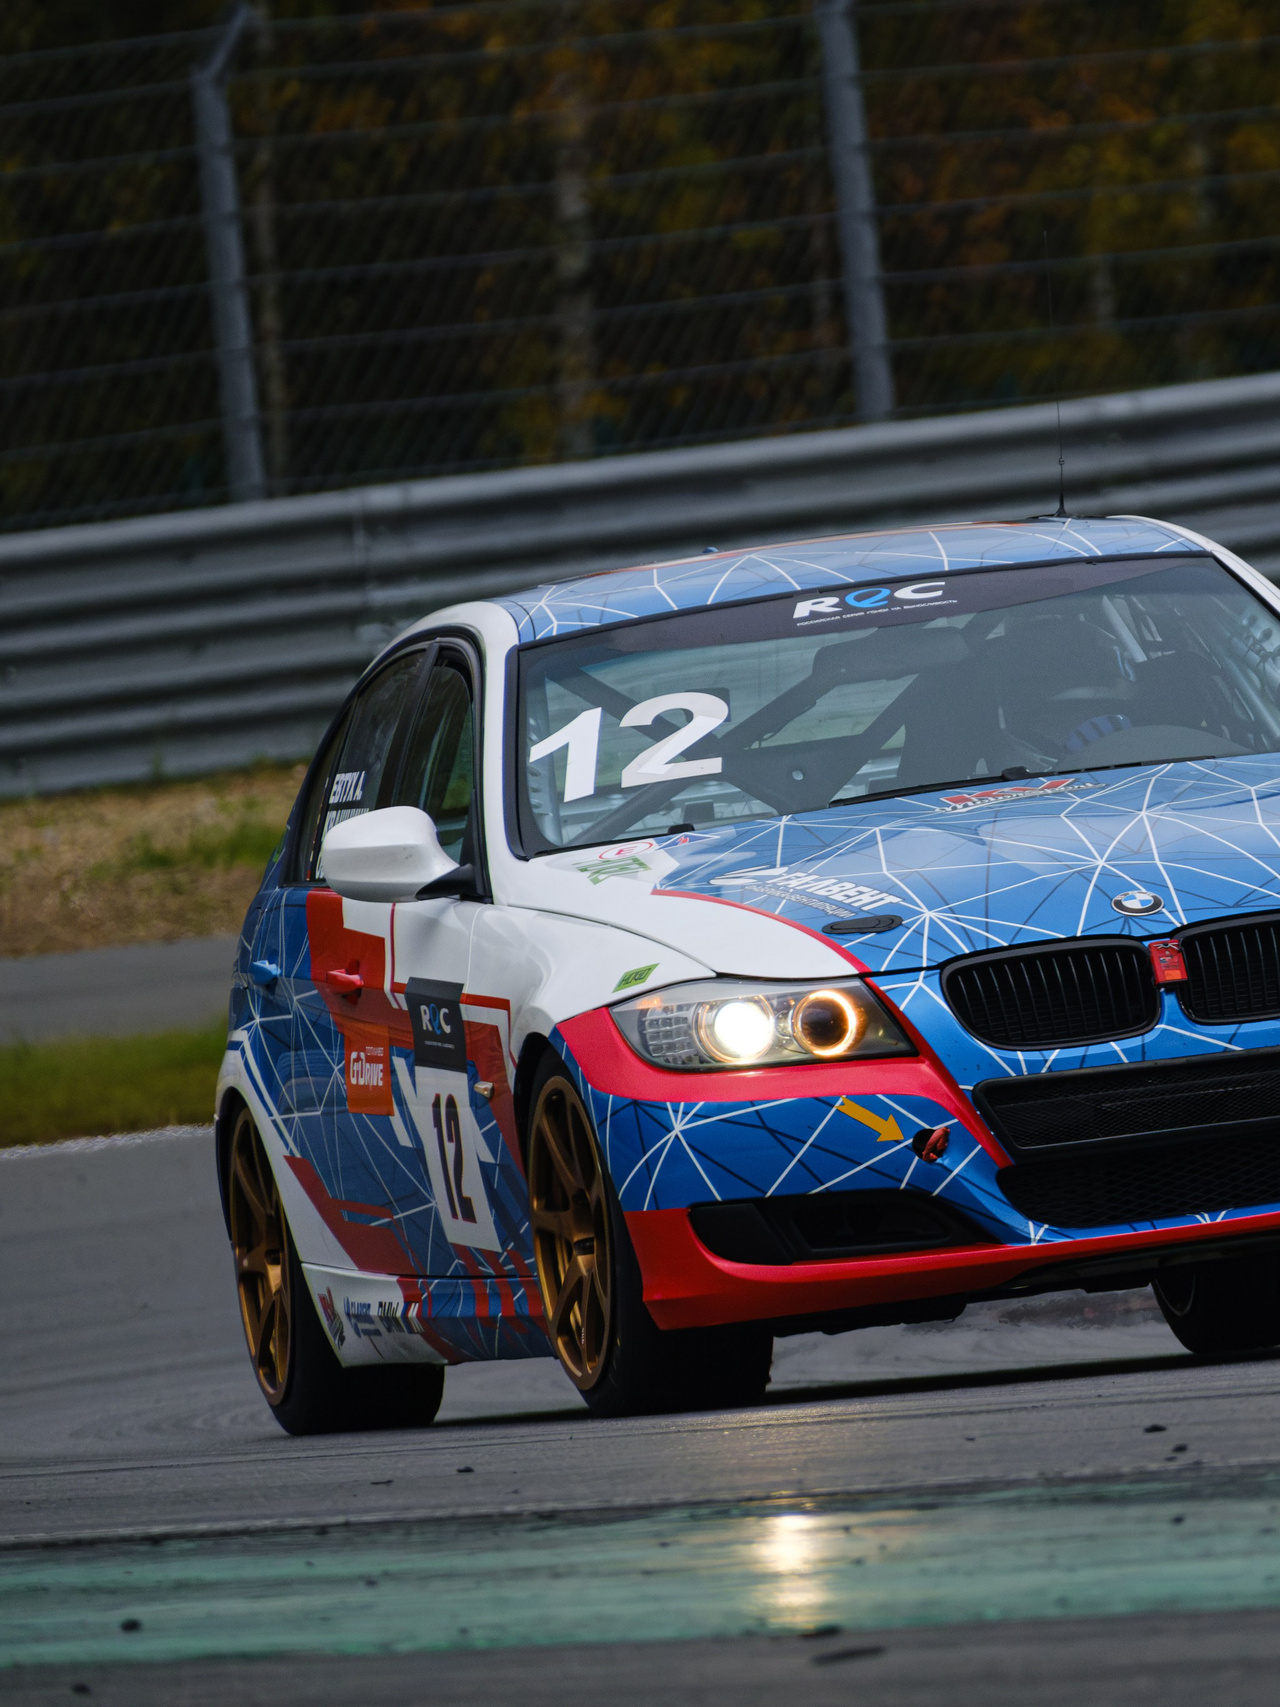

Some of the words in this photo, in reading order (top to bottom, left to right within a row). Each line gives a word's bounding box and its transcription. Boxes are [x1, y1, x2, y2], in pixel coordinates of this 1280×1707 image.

[529, 692, 729, 803] 12
[766, 872, 904, 911] ГАЛВЕНТ
[432, 1093, 478, 1224] 12
